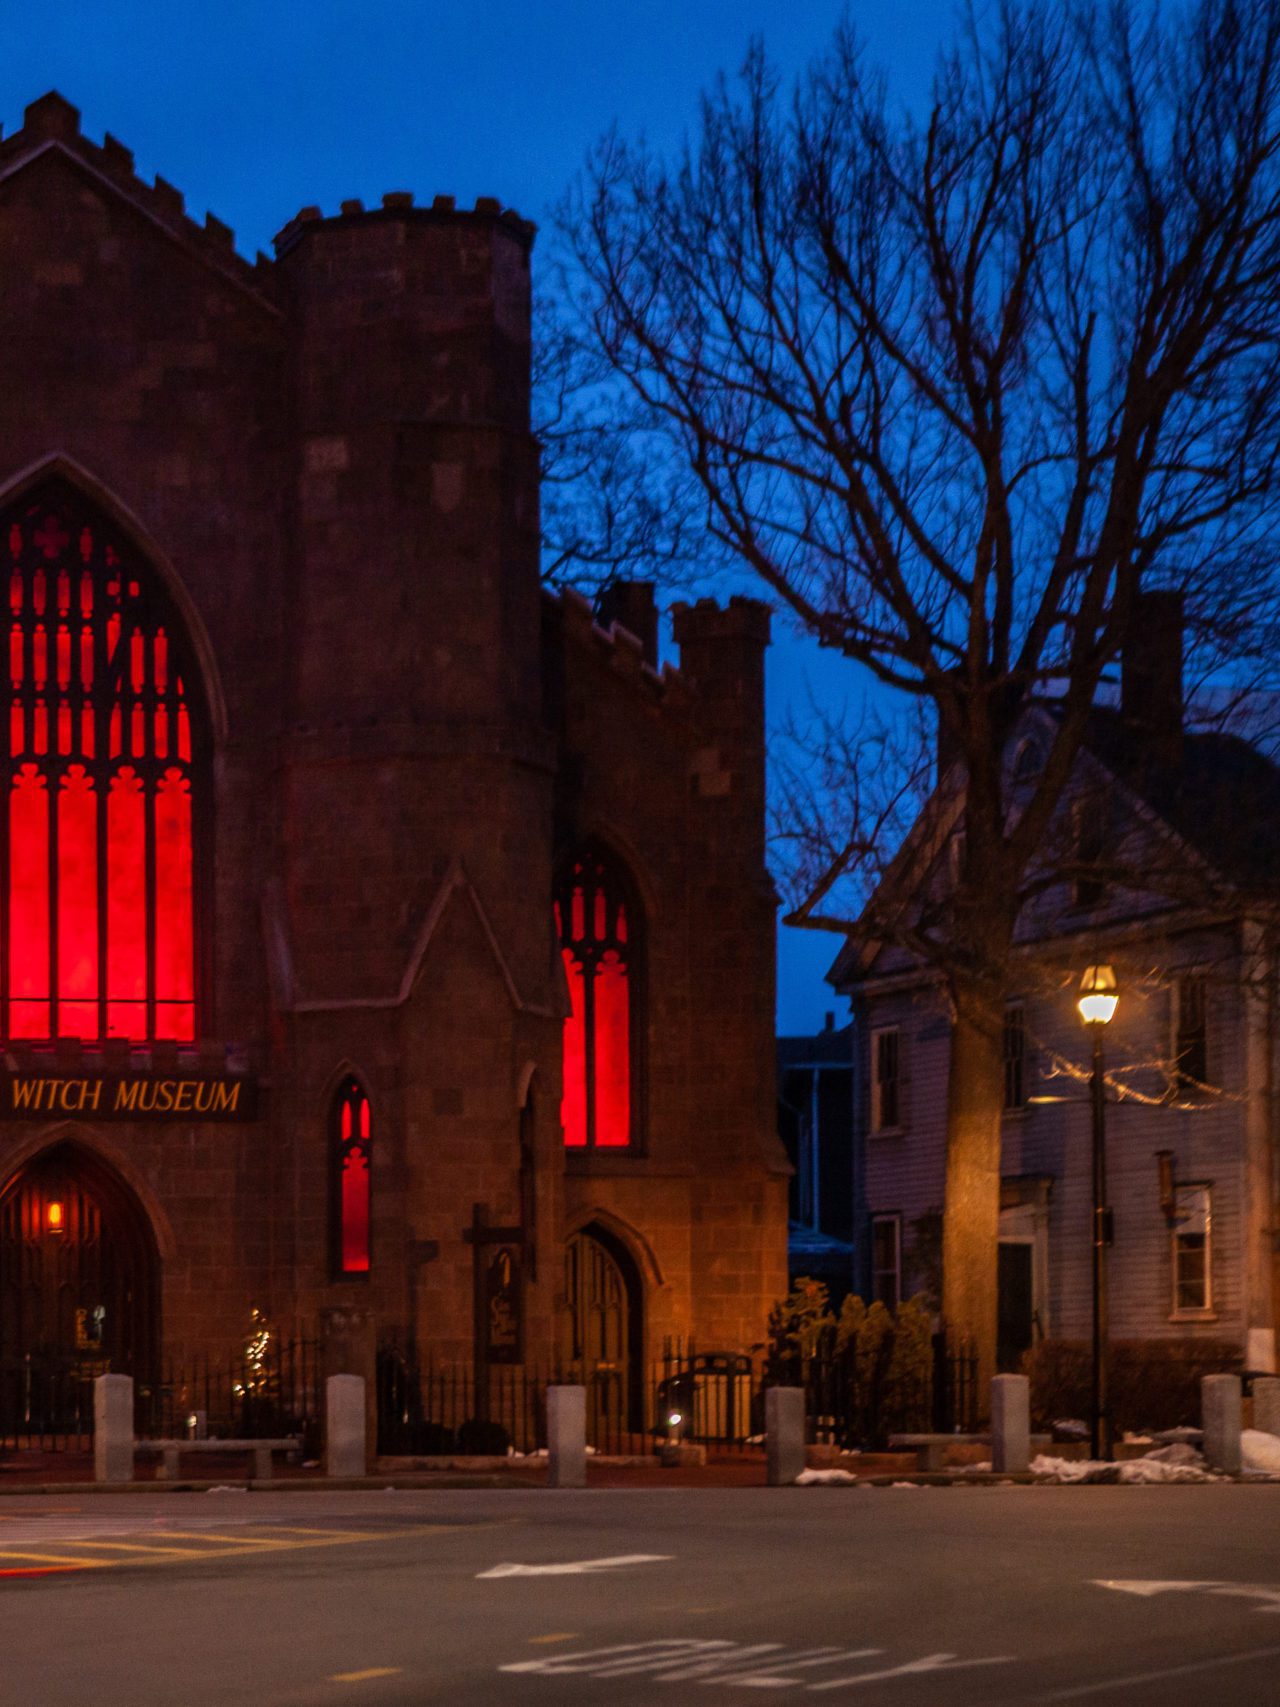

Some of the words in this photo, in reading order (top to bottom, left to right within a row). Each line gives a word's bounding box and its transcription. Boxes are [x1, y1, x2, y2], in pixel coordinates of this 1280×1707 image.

[12, 1079, 102, 1111] WITCH
[113, 1080, 241, 1113] MUSEUM
[497, 1638, 1018, 1691] ONLY
